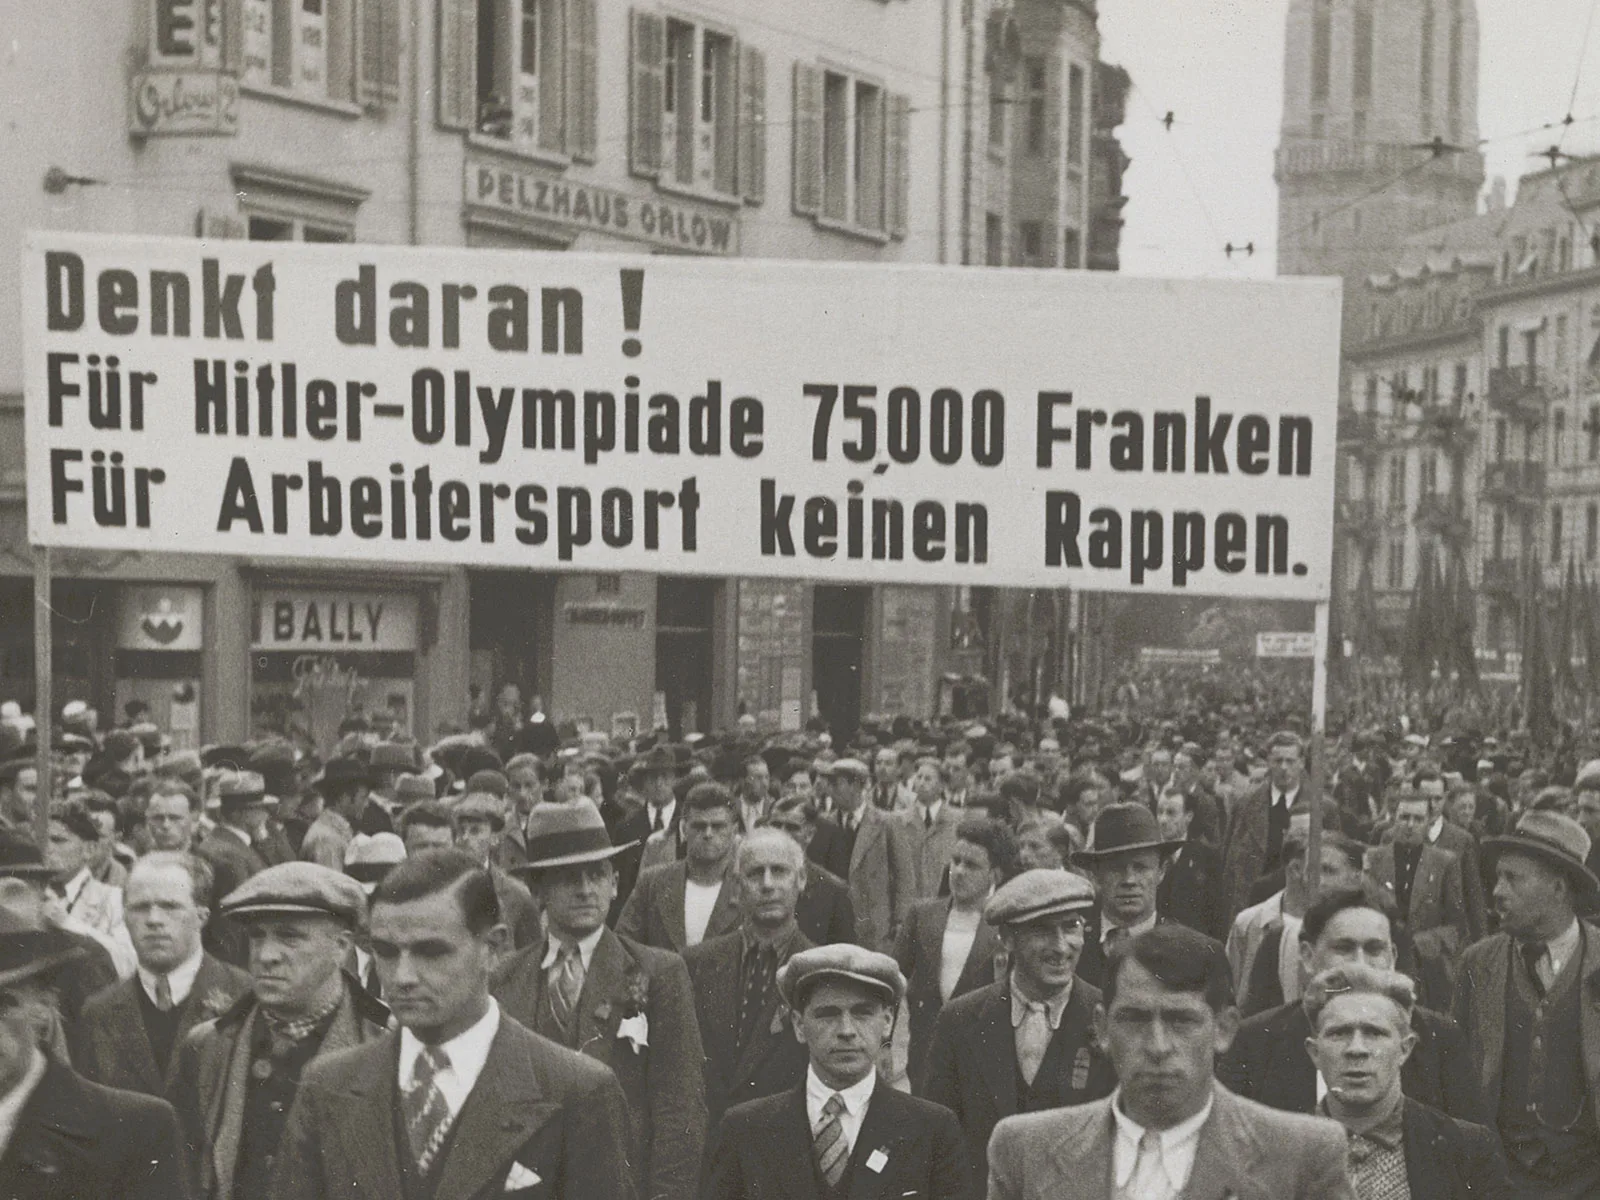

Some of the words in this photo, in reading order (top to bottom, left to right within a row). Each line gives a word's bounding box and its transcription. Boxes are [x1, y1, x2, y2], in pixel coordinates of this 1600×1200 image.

[477, 168, 629, 229] PELZHAUS
[640, 201, 731, 249] ORLOW
[45, 251, 276, 340] Denkt
[47, 352, 158, 431] Für
[193, 359, 764, 465] Hitler-Olympiade
[1036, 391, 1313, 476] Franken
[50, 448, 166, 528] Für
[216, 457, 700, 561] Arbeitersport
[760, 478, 988, 564] keinen
[1044, 490, 1309, 585] Rappen.
[274, 601, 383, 642] BALLY
